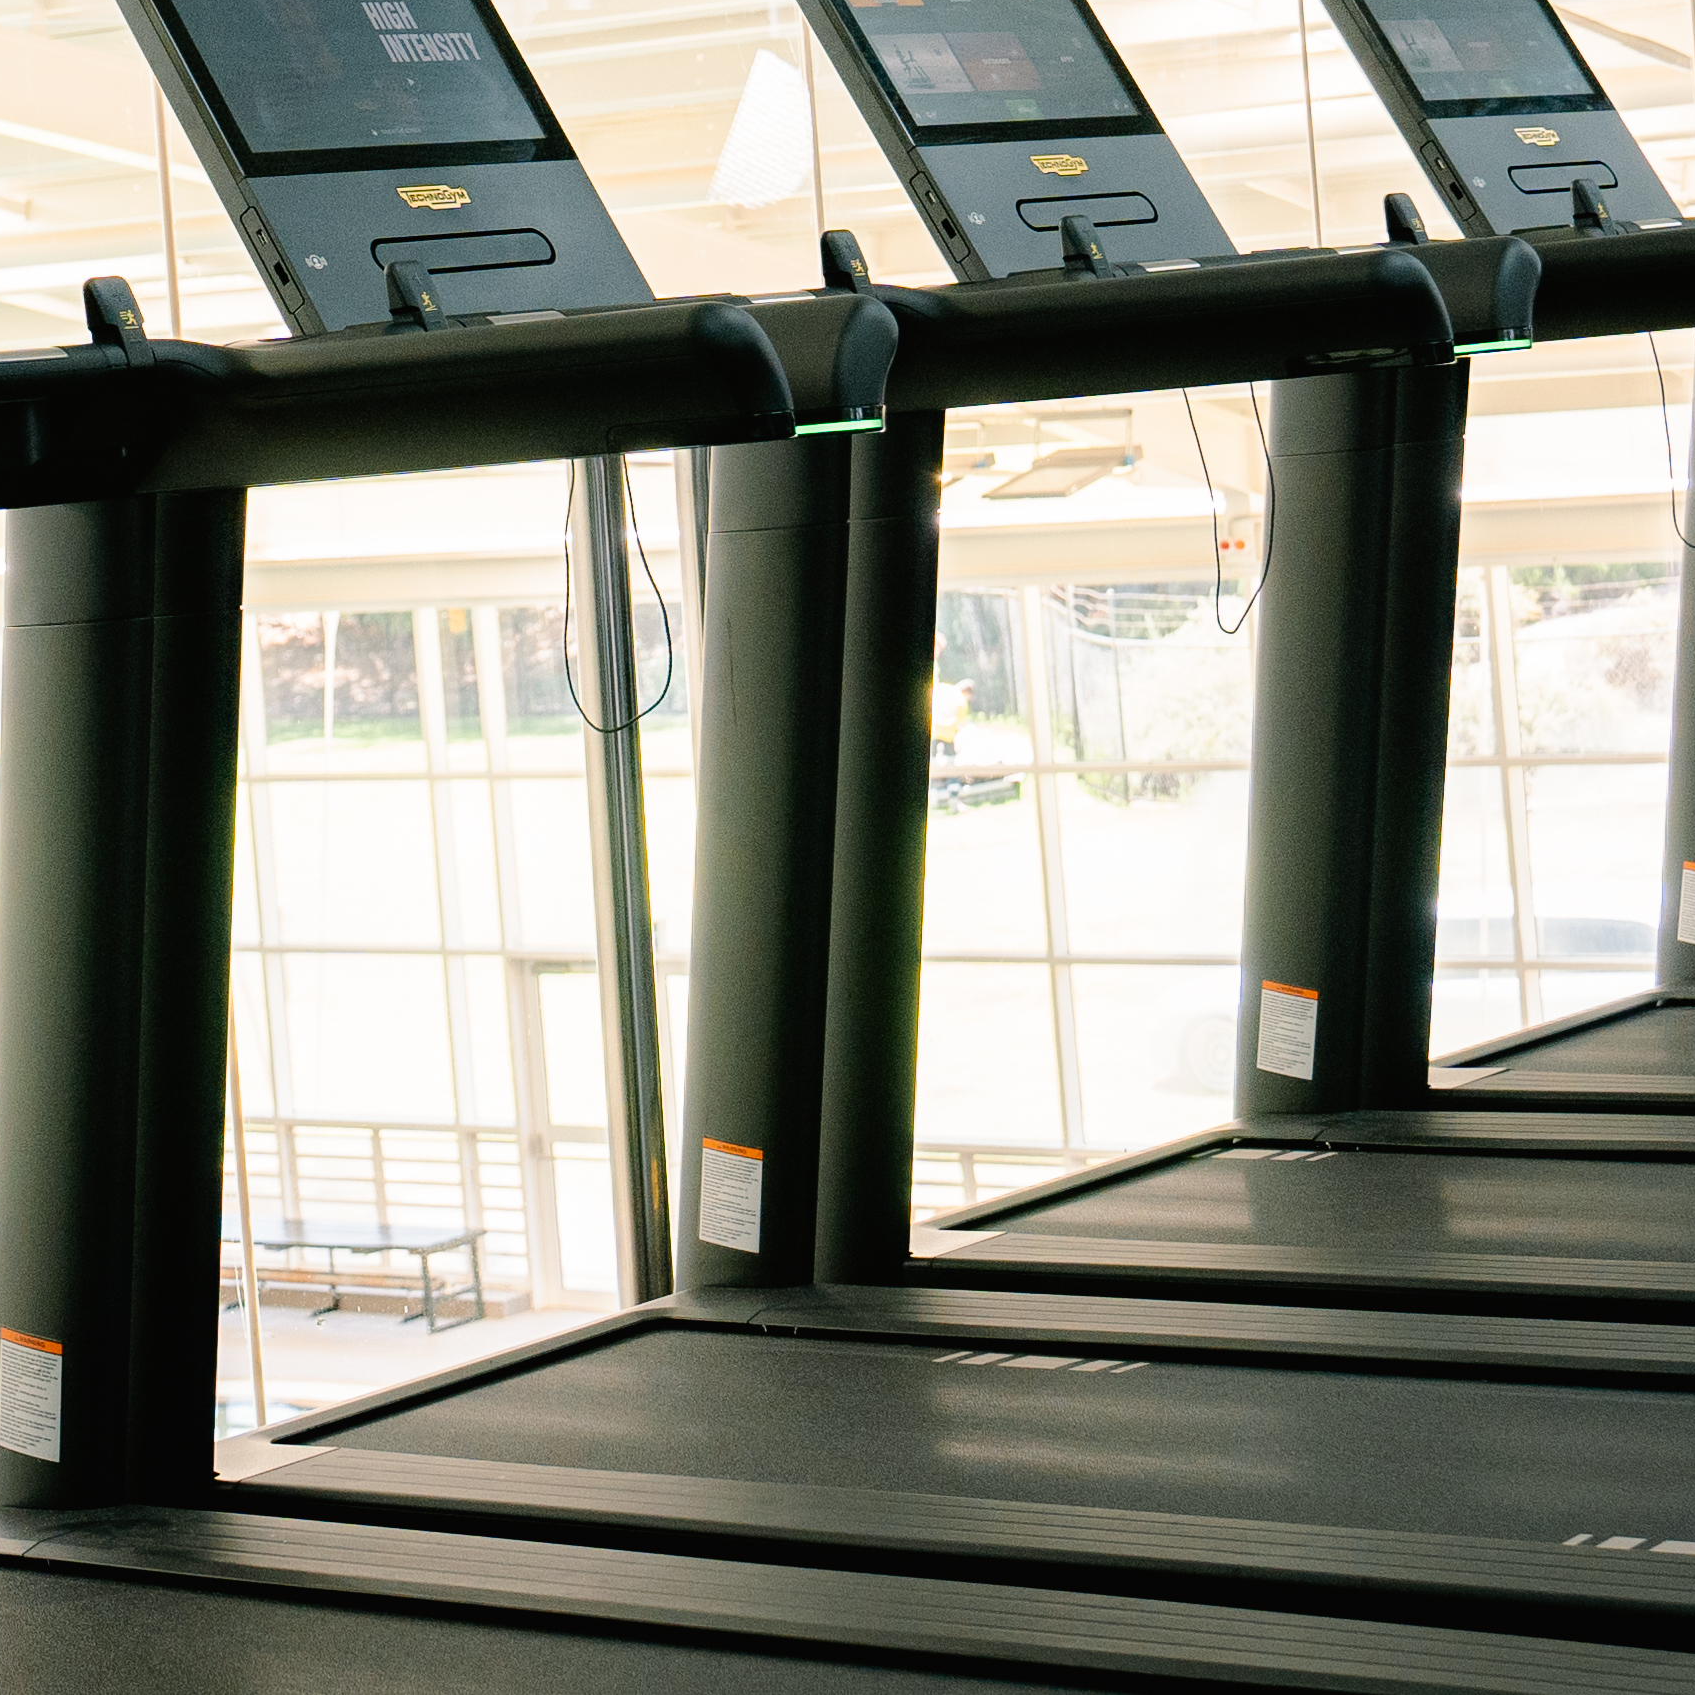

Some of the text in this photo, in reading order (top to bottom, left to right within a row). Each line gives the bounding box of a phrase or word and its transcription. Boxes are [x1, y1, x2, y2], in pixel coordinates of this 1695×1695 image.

[362, 1, 418, 30] HIGH
[379, 32, 481, 63] INTENSITY
[398, 187, 467, 205] TECHNOGYM
